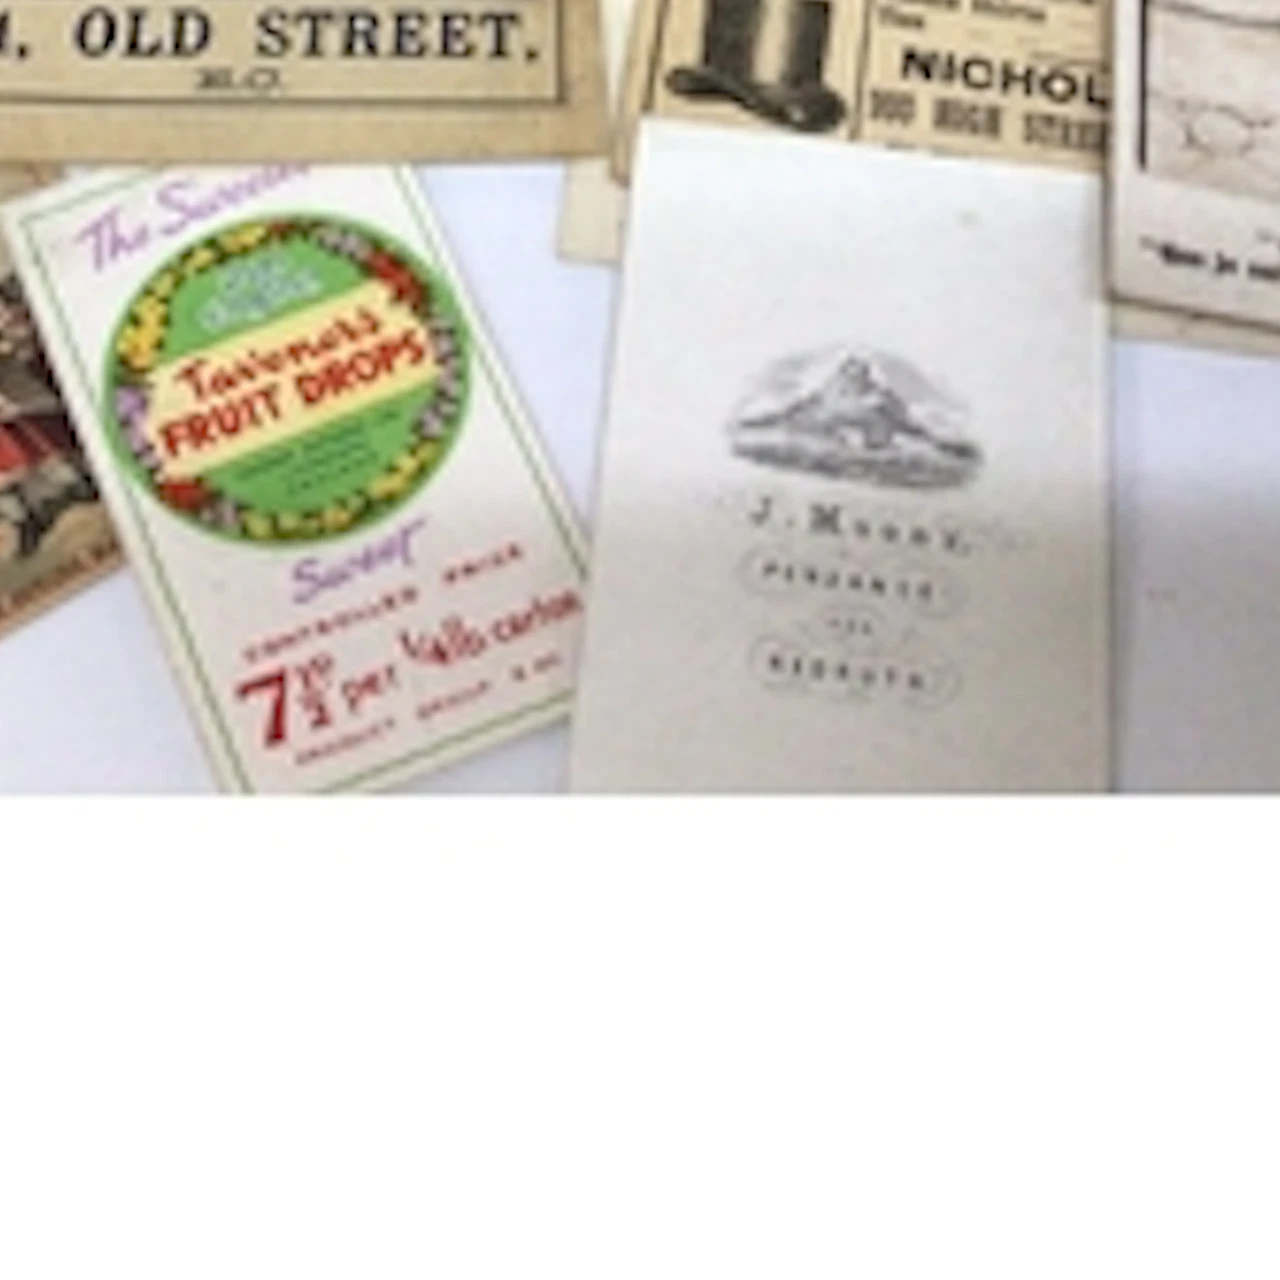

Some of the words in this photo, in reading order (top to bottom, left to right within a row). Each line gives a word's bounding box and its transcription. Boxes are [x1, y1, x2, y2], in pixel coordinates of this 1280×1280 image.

[72, 7, 212, 59] OLD
[255, 10, 541, 62] STREET.
[76, 206, 150, 270] The
[158, 384, 285, 458] FRUIT
[296, 330, 429, 404] DROPS
[338, 665, 400, 716] per
[491, 589, 585, 645] carton
